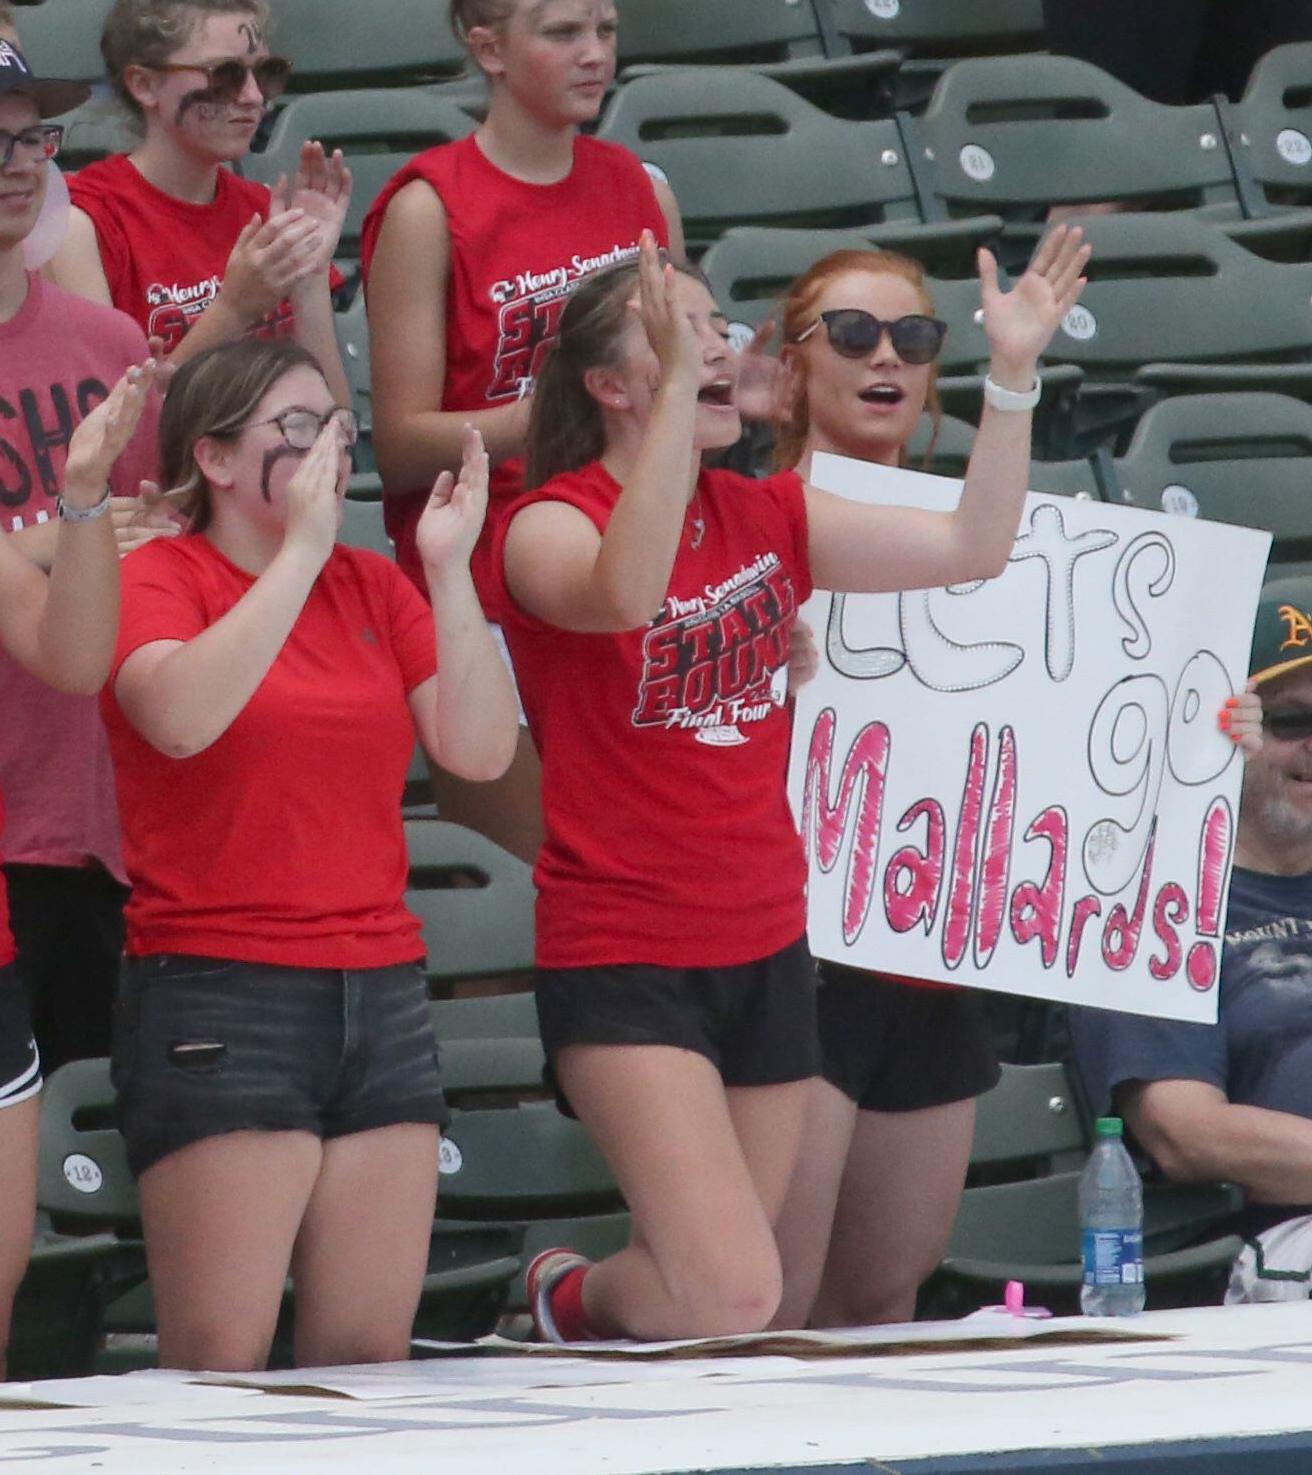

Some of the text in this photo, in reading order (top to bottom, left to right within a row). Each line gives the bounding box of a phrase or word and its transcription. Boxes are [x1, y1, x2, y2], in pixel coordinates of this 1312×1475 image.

[668, 551, 780, 618] Henry-Senachwin
[667, 698, 772, 730] Final Four
[1083, 648, 1240, 896] go
[801, 706, 1234, 993] Mallards!
[73, 1164, 93, 1182] 12
